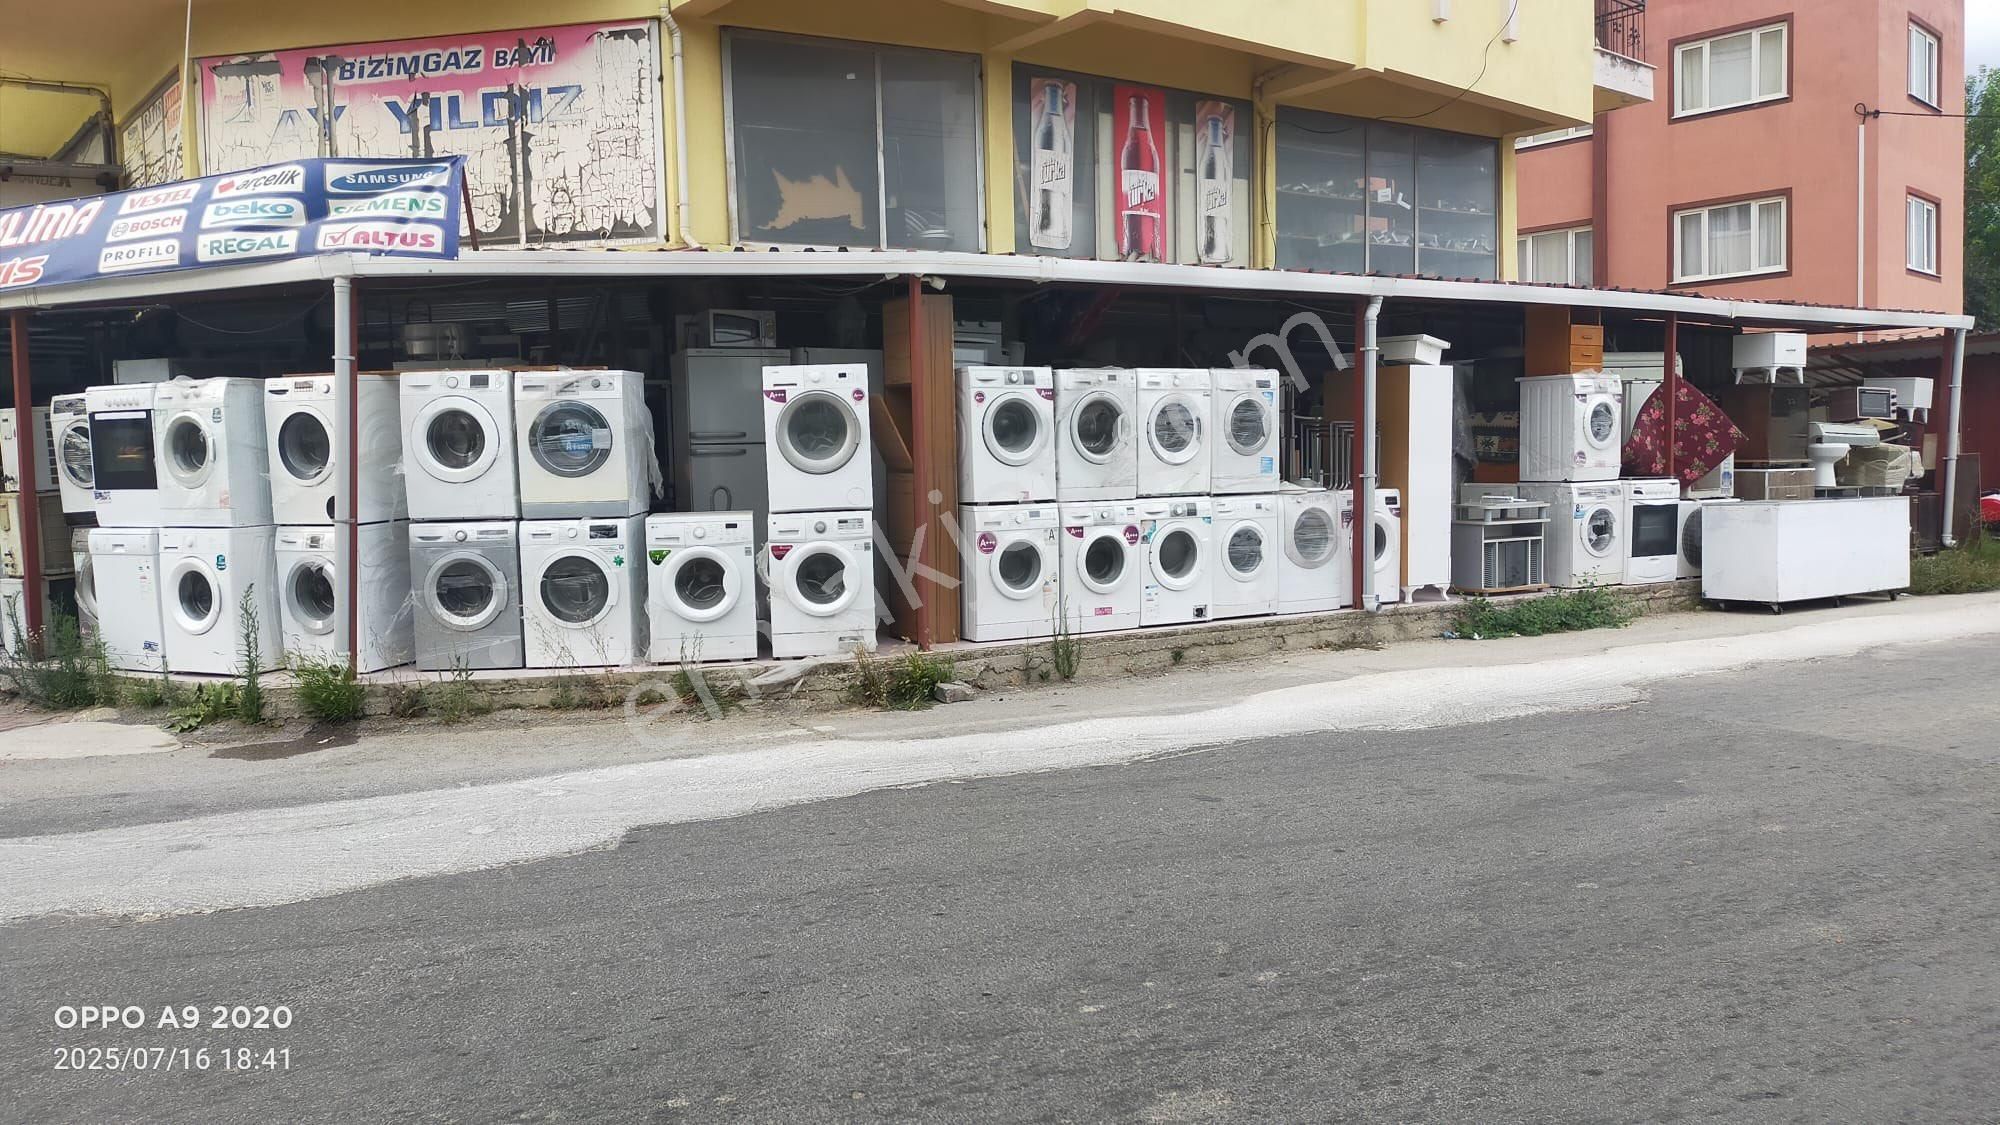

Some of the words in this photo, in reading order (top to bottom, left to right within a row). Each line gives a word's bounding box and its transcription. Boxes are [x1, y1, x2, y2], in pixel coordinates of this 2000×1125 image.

[384, 84, 582, 134] YILDIZ
[235, 169, 301, 191] arçelik
[345, 171, 433, 184] SAMSUNG
[128, 187, 193, 210] VESTEL
[213, 200, 295, 217] beko
[129, 214, 184, 233] BOSCH
[209, 235, 290, 256] REGAL
[352, 230, 436, 248] ALTUS
[980, 538, 996, 547] A+++
